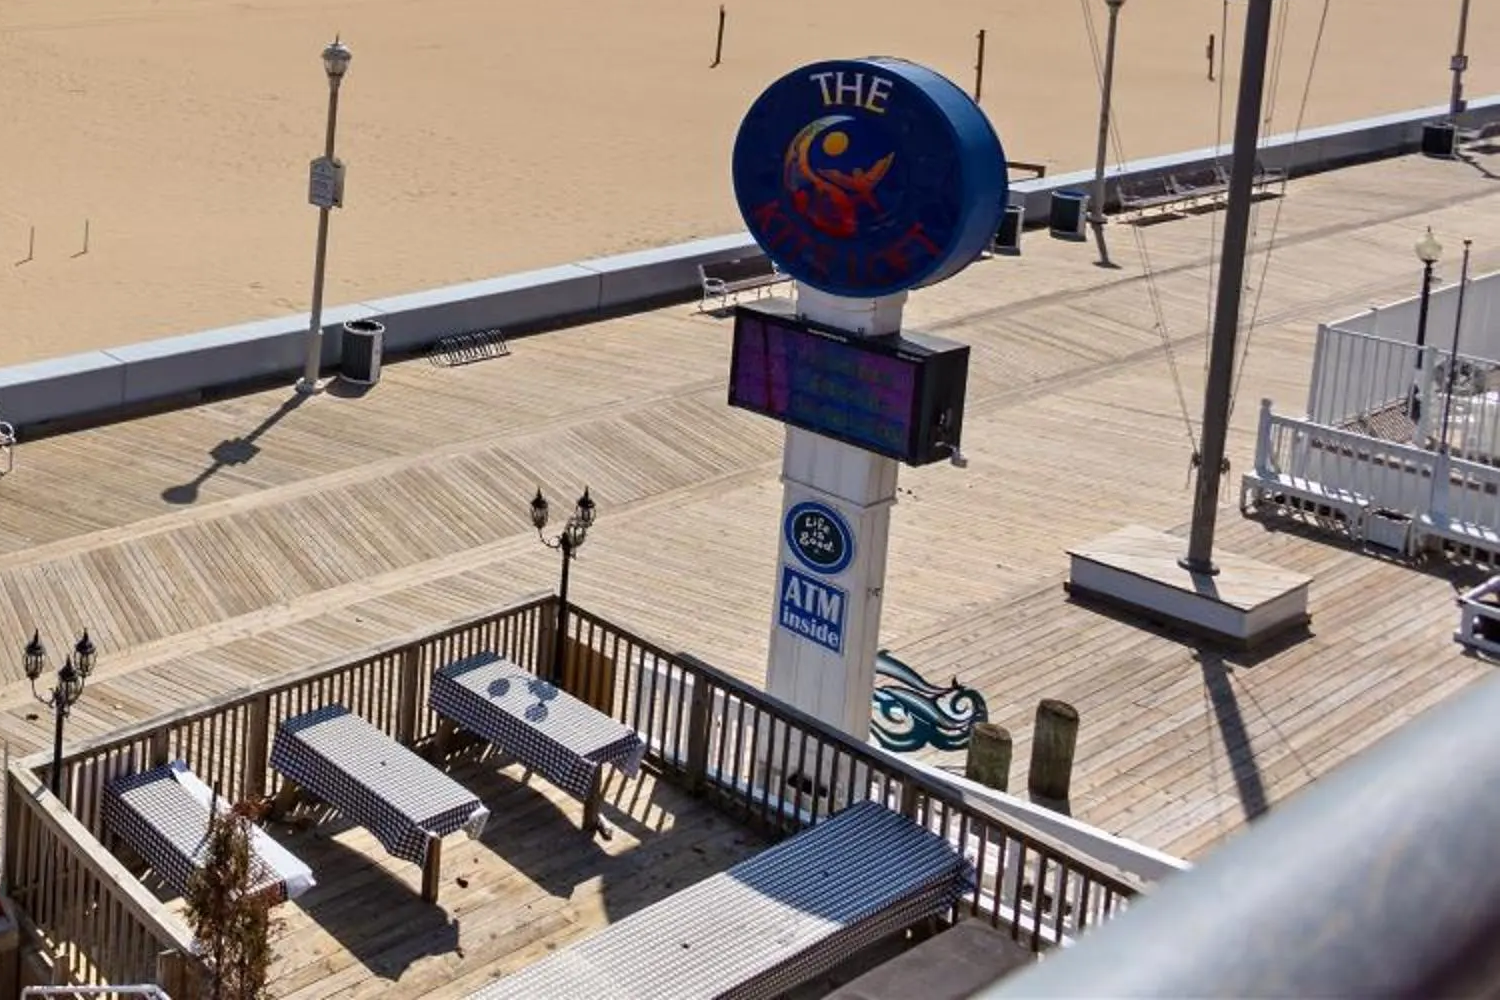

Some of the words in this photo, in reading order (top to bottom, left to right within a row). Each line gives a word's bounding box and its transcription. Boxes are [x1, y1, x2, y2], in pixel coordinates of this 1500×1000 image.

[810, 71, 893, 113] THE
[805, 516, 830, 534] Life
[813, 528, 825, 540] is
[785, 576, 841, 622] ATM
[782, 606, 839, 647] inside
